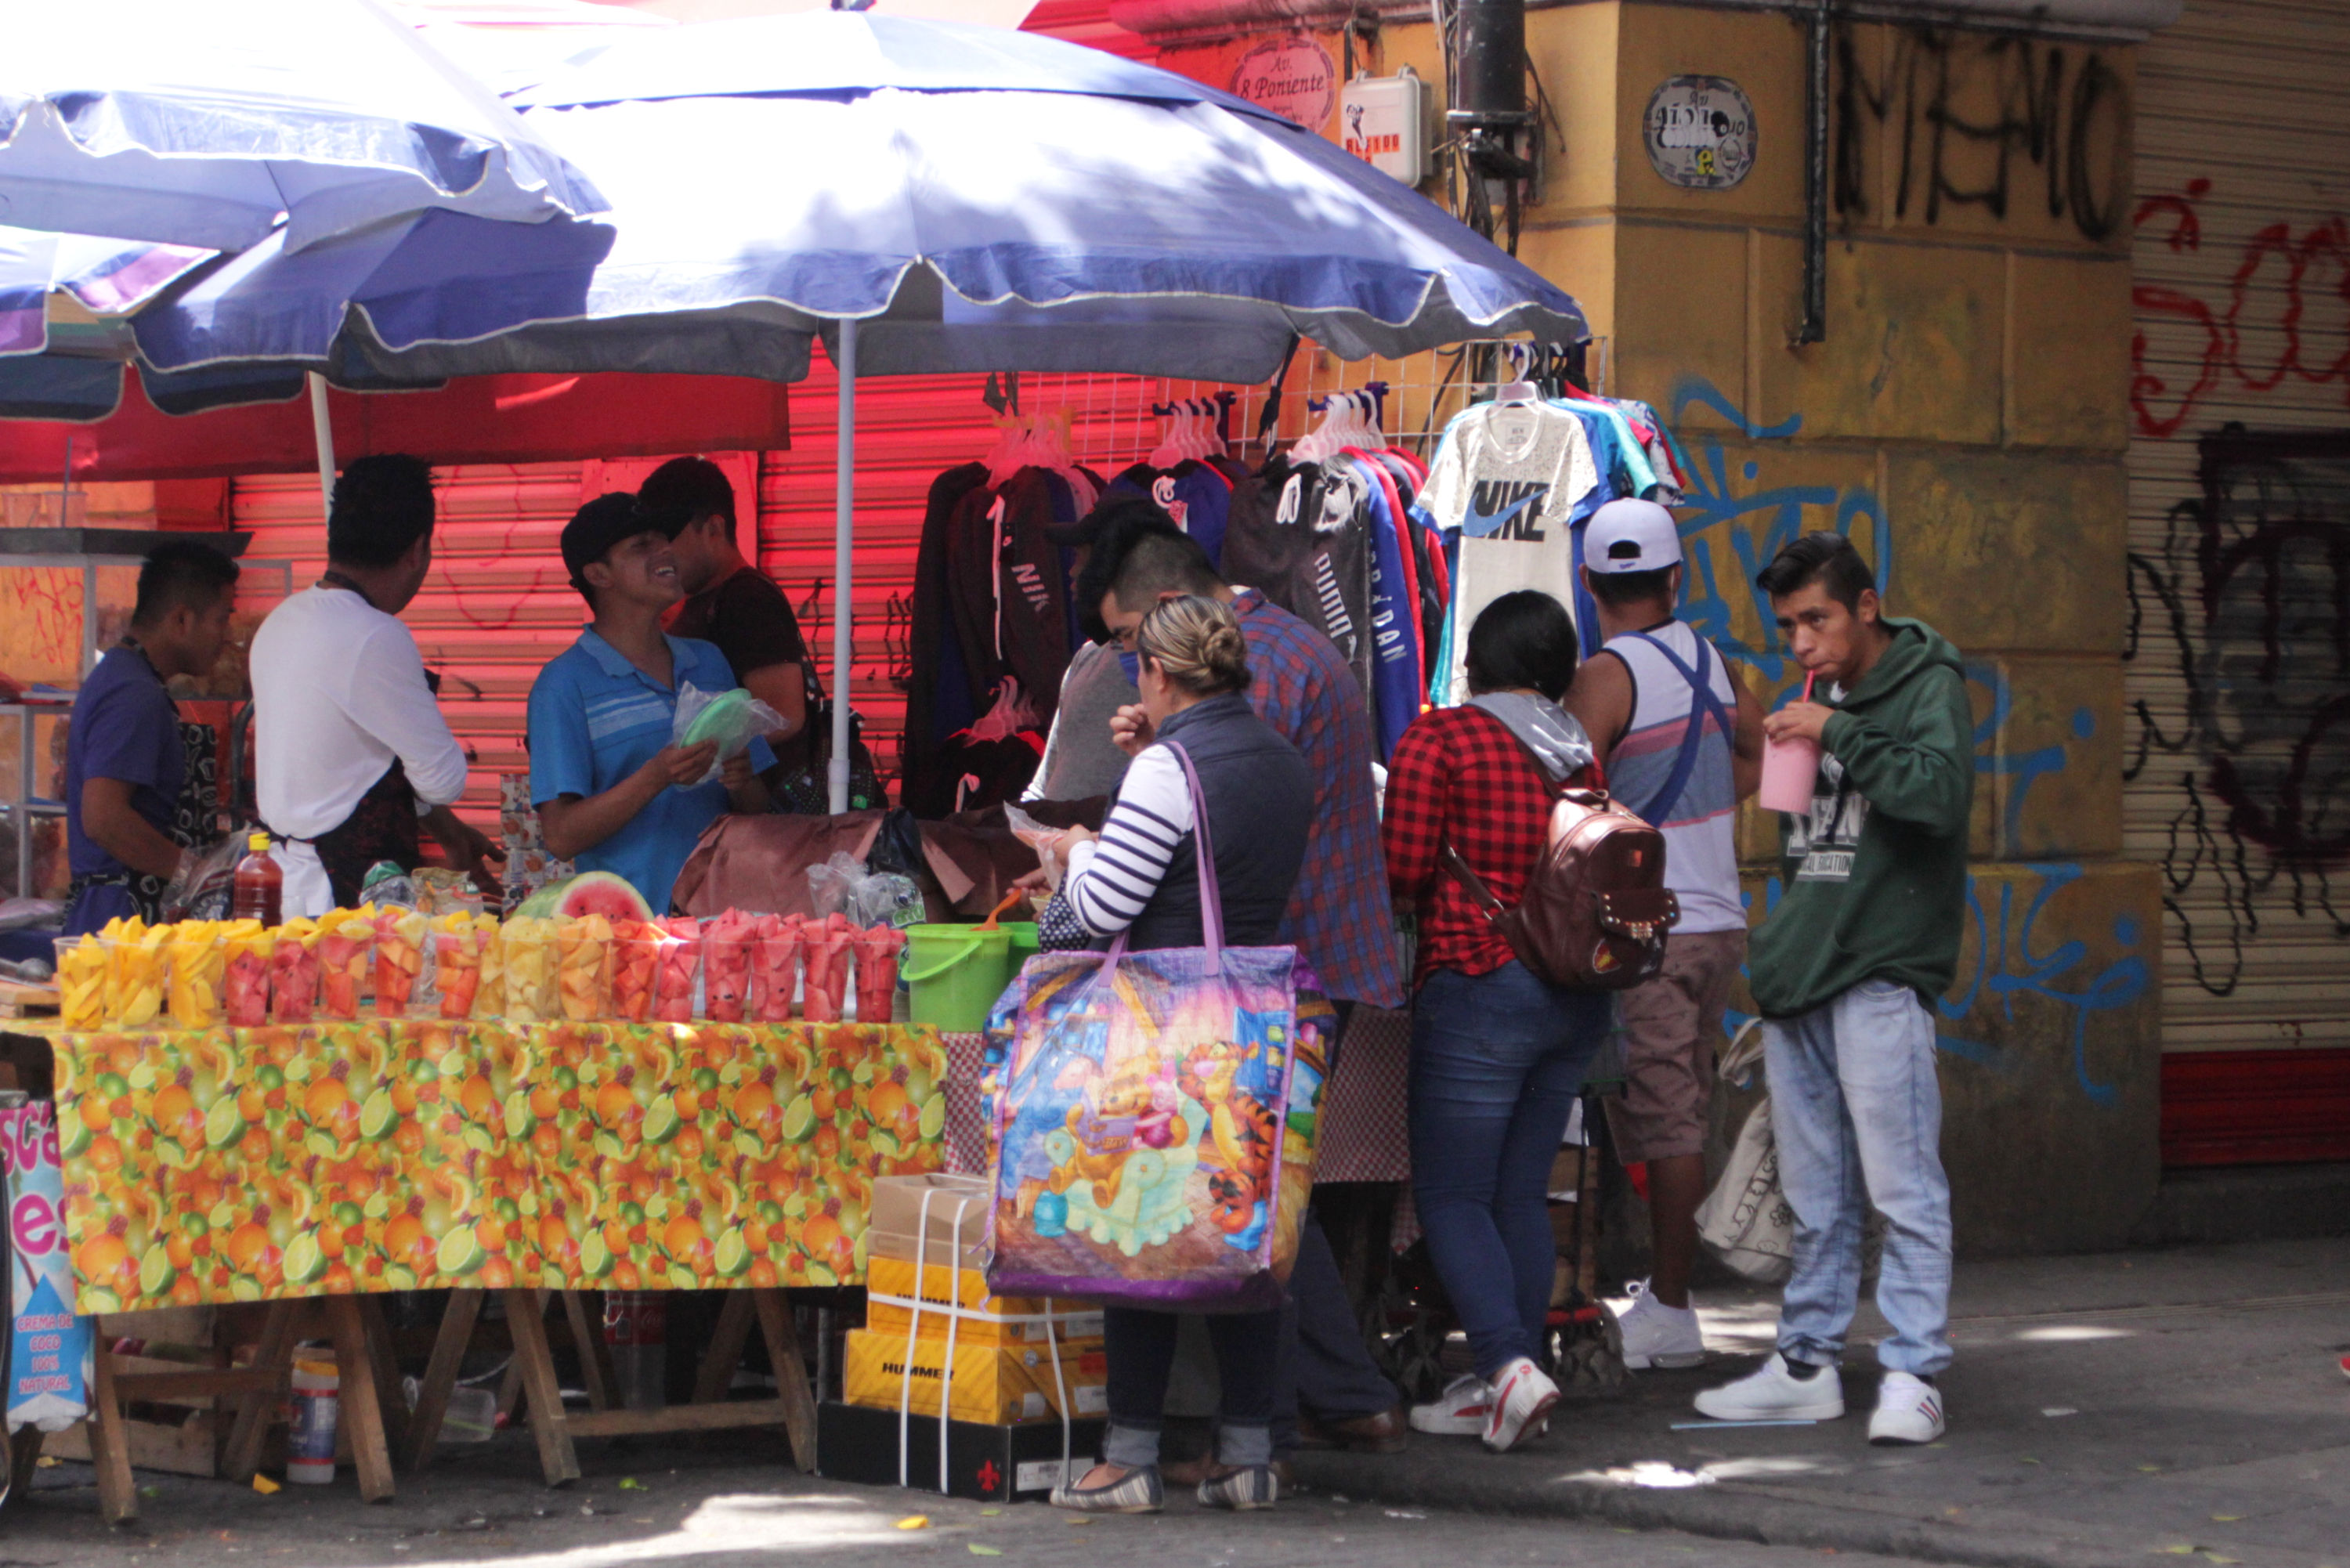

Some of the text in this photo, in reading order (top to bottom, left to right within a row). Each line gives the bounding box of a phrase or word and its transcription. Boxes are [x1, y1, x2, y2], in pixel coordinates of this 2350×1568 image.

[1240, 73, 1325, 99] 8 Poniente
[1471, 480, 1549, 541] NIKE
[1314, 551, 1353, 638] PUMA
[16, 1313, 74, 1332] CREMA DE
[29, 1334, 61, 1352] COCO
[31, 1354, 60, 1373] 100%
[18, 1374, 71, 1396] NATURAL
